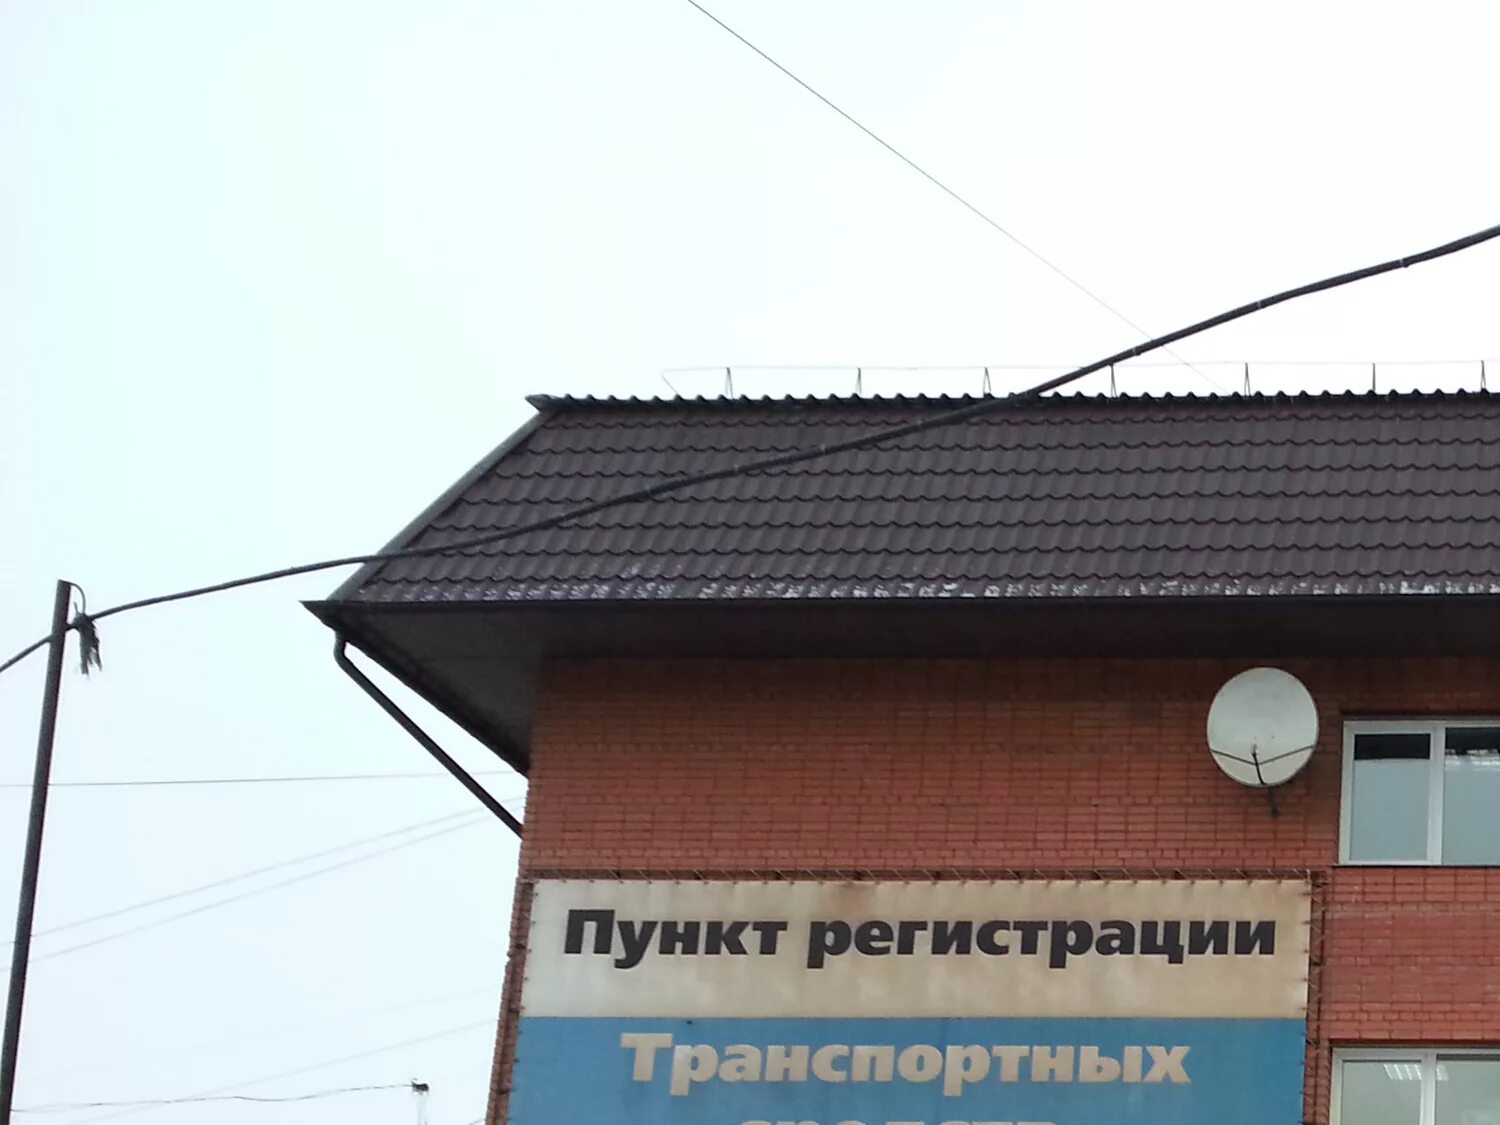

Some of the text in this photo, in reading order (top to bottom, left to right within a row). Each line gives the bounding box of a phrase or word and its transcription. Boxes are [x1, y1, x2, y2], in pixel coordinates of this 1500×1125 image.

[563, 908, 1276, 970] Пункт регистрации
[620, 1031, 1192, 1096] Транспортных
